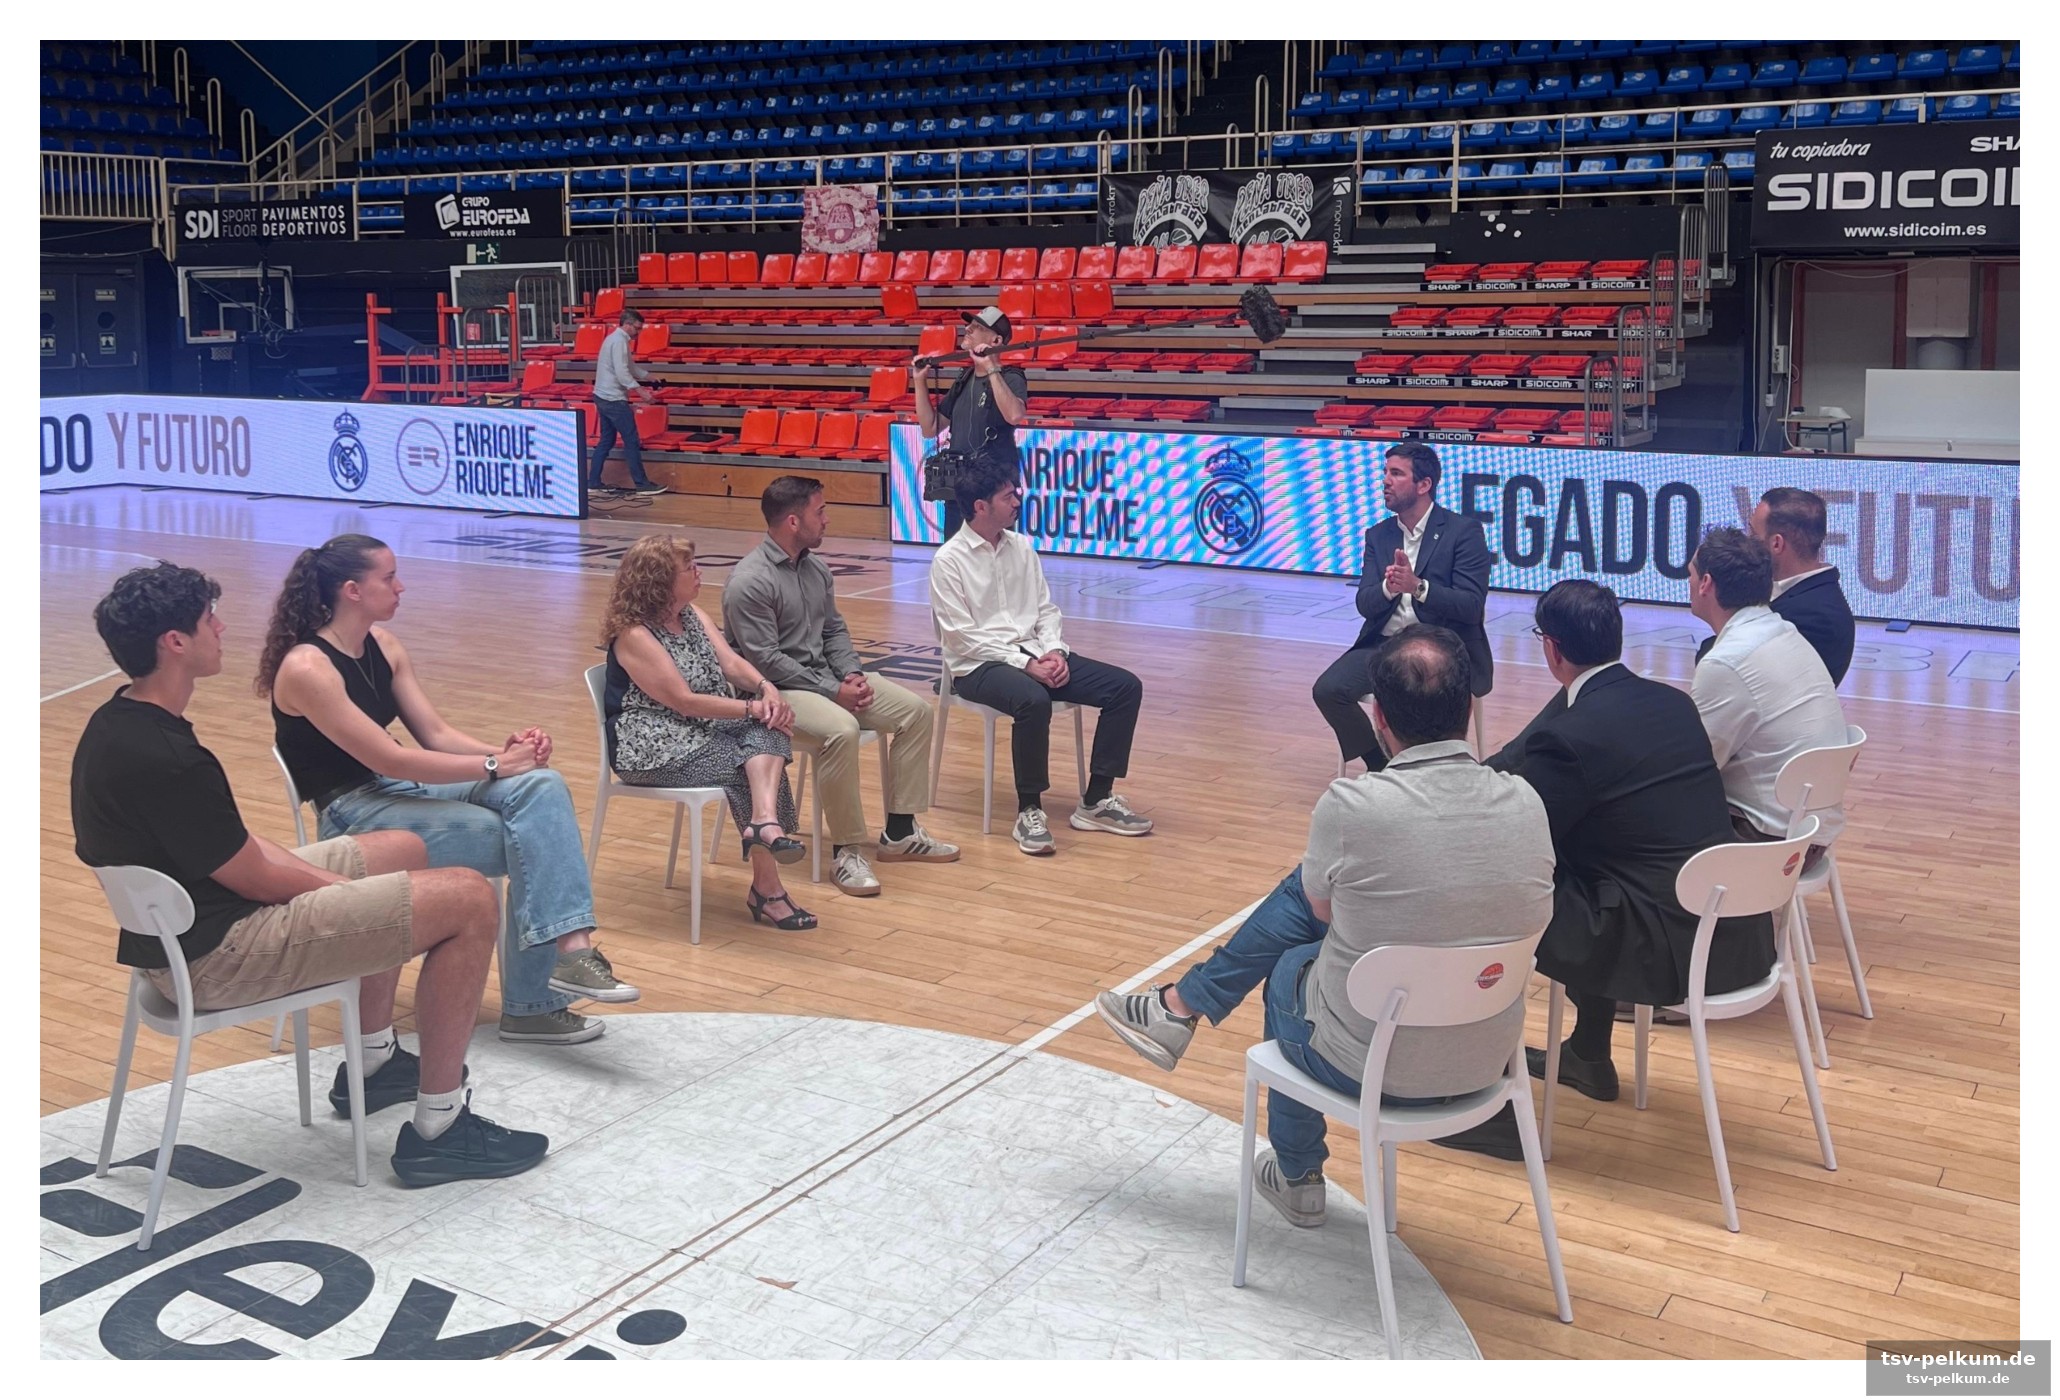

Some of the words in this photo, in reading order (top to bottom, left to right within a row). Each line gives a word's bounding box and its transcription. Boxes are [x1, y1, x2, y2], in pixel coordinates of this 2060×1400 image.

[1770, 142, 1789, 159] tu
[1791, 138, 1871, 162] copiadora
[461, 196, 490, 207] GRUPO
[222, 208, 257, 223] SPORT
[262, 205, 345, 221] PAVIMENTOS
[462, 207, 531, 226] EUROFESA
[184, 209, 220, 239] SDI
[222, 224, 257, 238] FLOOR
[262, 220, 347, 236] DEPORTIVOS
[1844, 222, 1987, 238] www.sidicoim.es
[450, 228, 516, 237] www.eurofesa.es
[1534, 282, 1571, 290] SHARP
[1355, 377, 1390, 385] SHARP
[1470, 379, 1509, 387] SHARP
[106, 412, 129, 470] Y
[137, 412, 250, 478] FUTURO
[454, 422, 537, 461] ENRIQUE
[1018, 447, 1116, 494] NRIQUE
[456, 460, 554, 500] RIQUELME
[1016, 495, 1139, 543] IQUELME
[1462, 472, 1702, 580] EGADO
